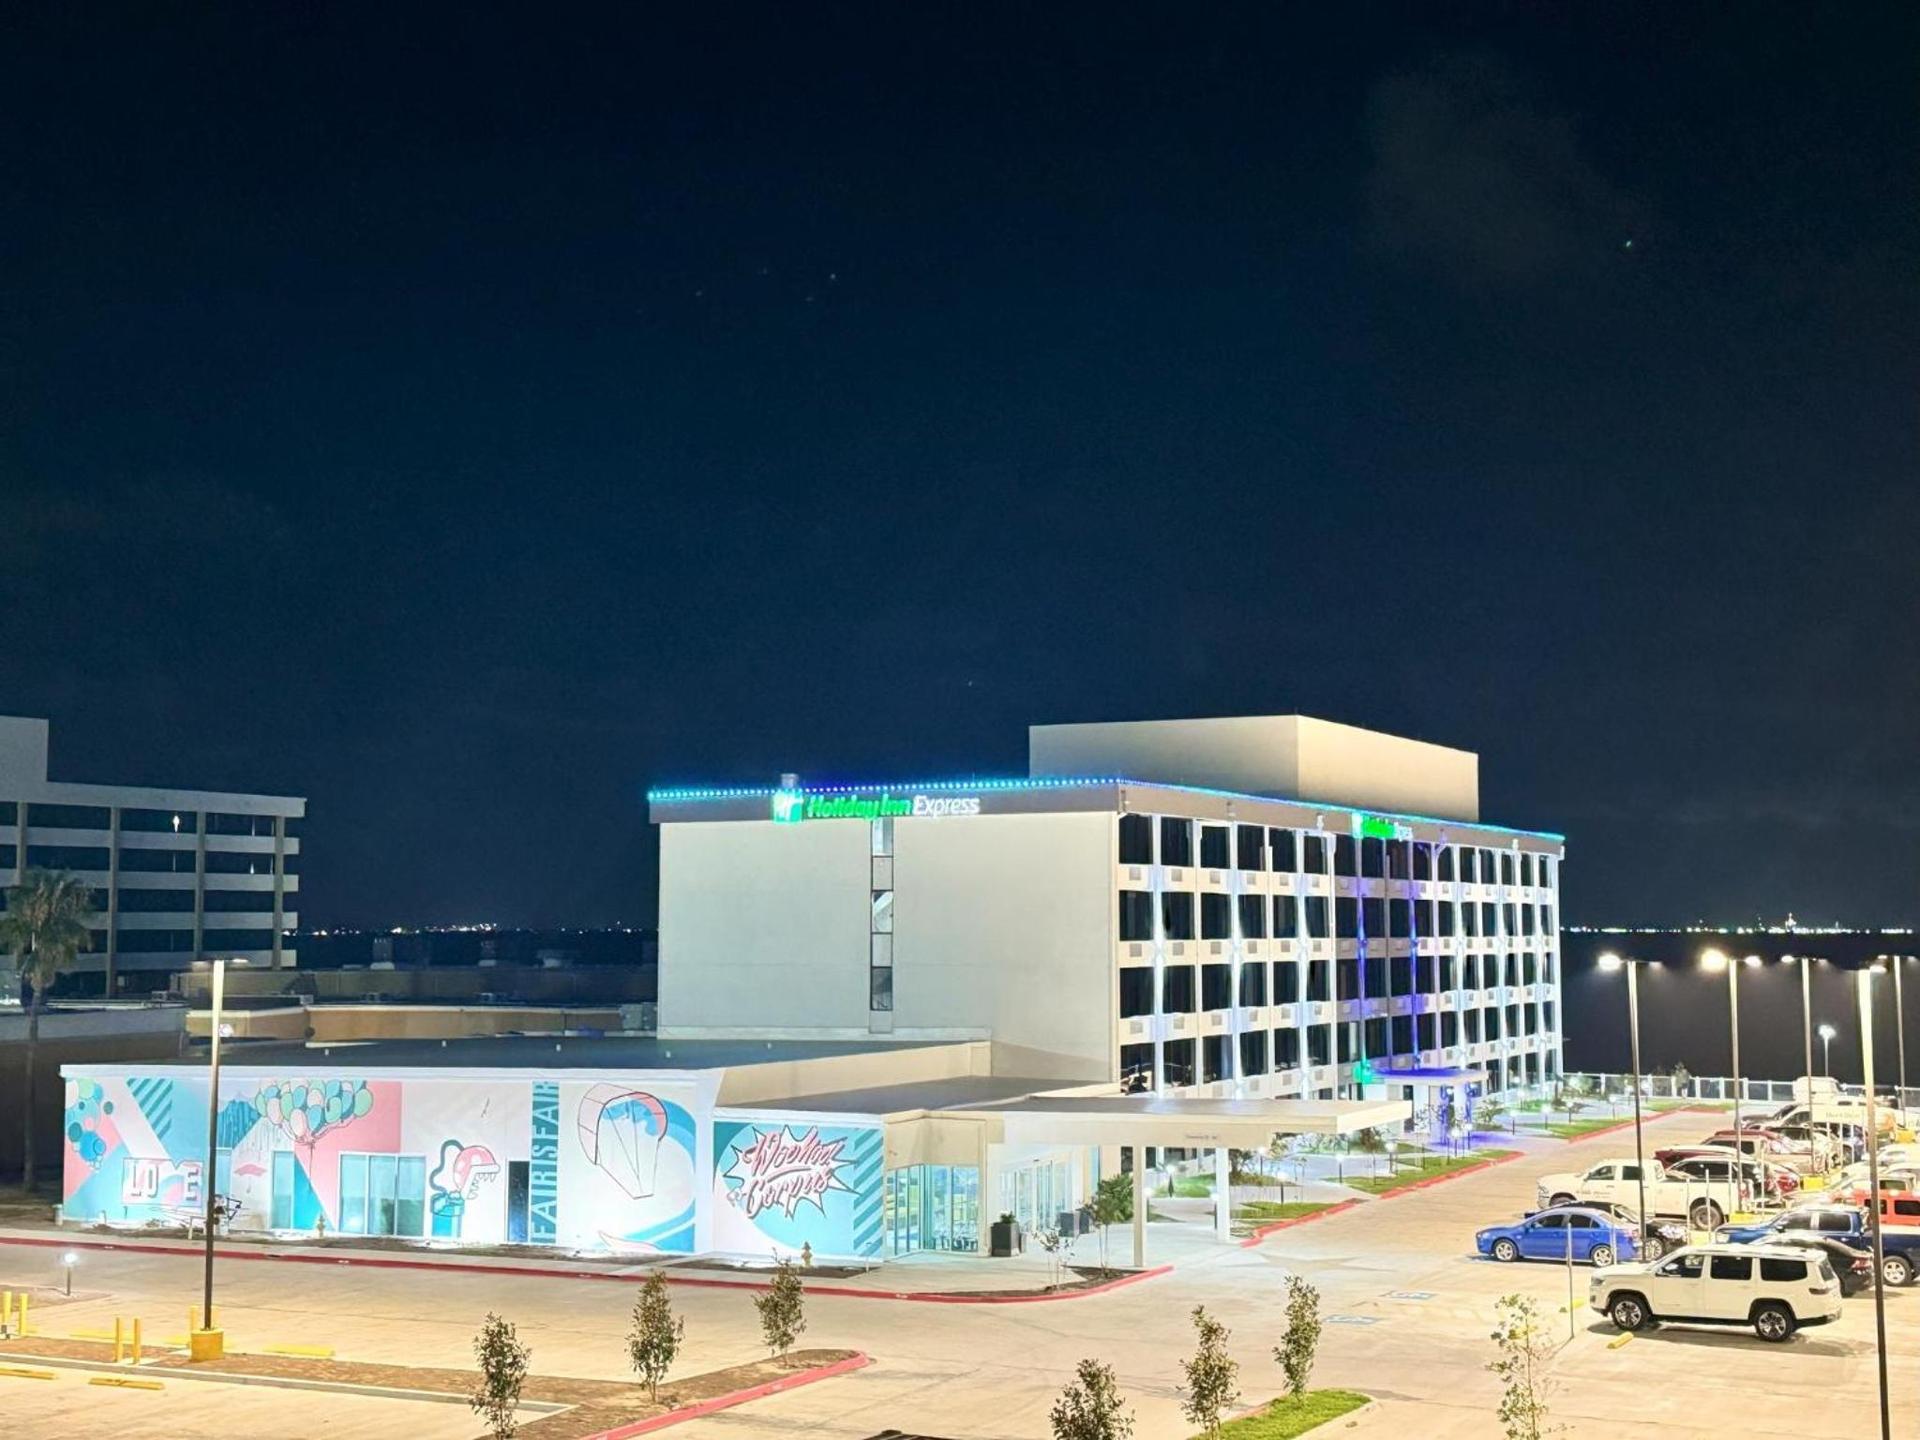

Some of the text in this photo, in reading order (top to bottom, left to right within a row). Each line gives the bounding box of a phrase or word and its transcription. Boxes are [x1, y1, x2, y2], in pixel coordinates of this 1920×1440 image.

[807, 793, 981, 819] Holiday Inn Express
[125, 1162, 201, 1202] LOE
[531, 1081, 559, 1240] FAIR IS FAIR
[747, 1167, 834, 1219] Corpus
